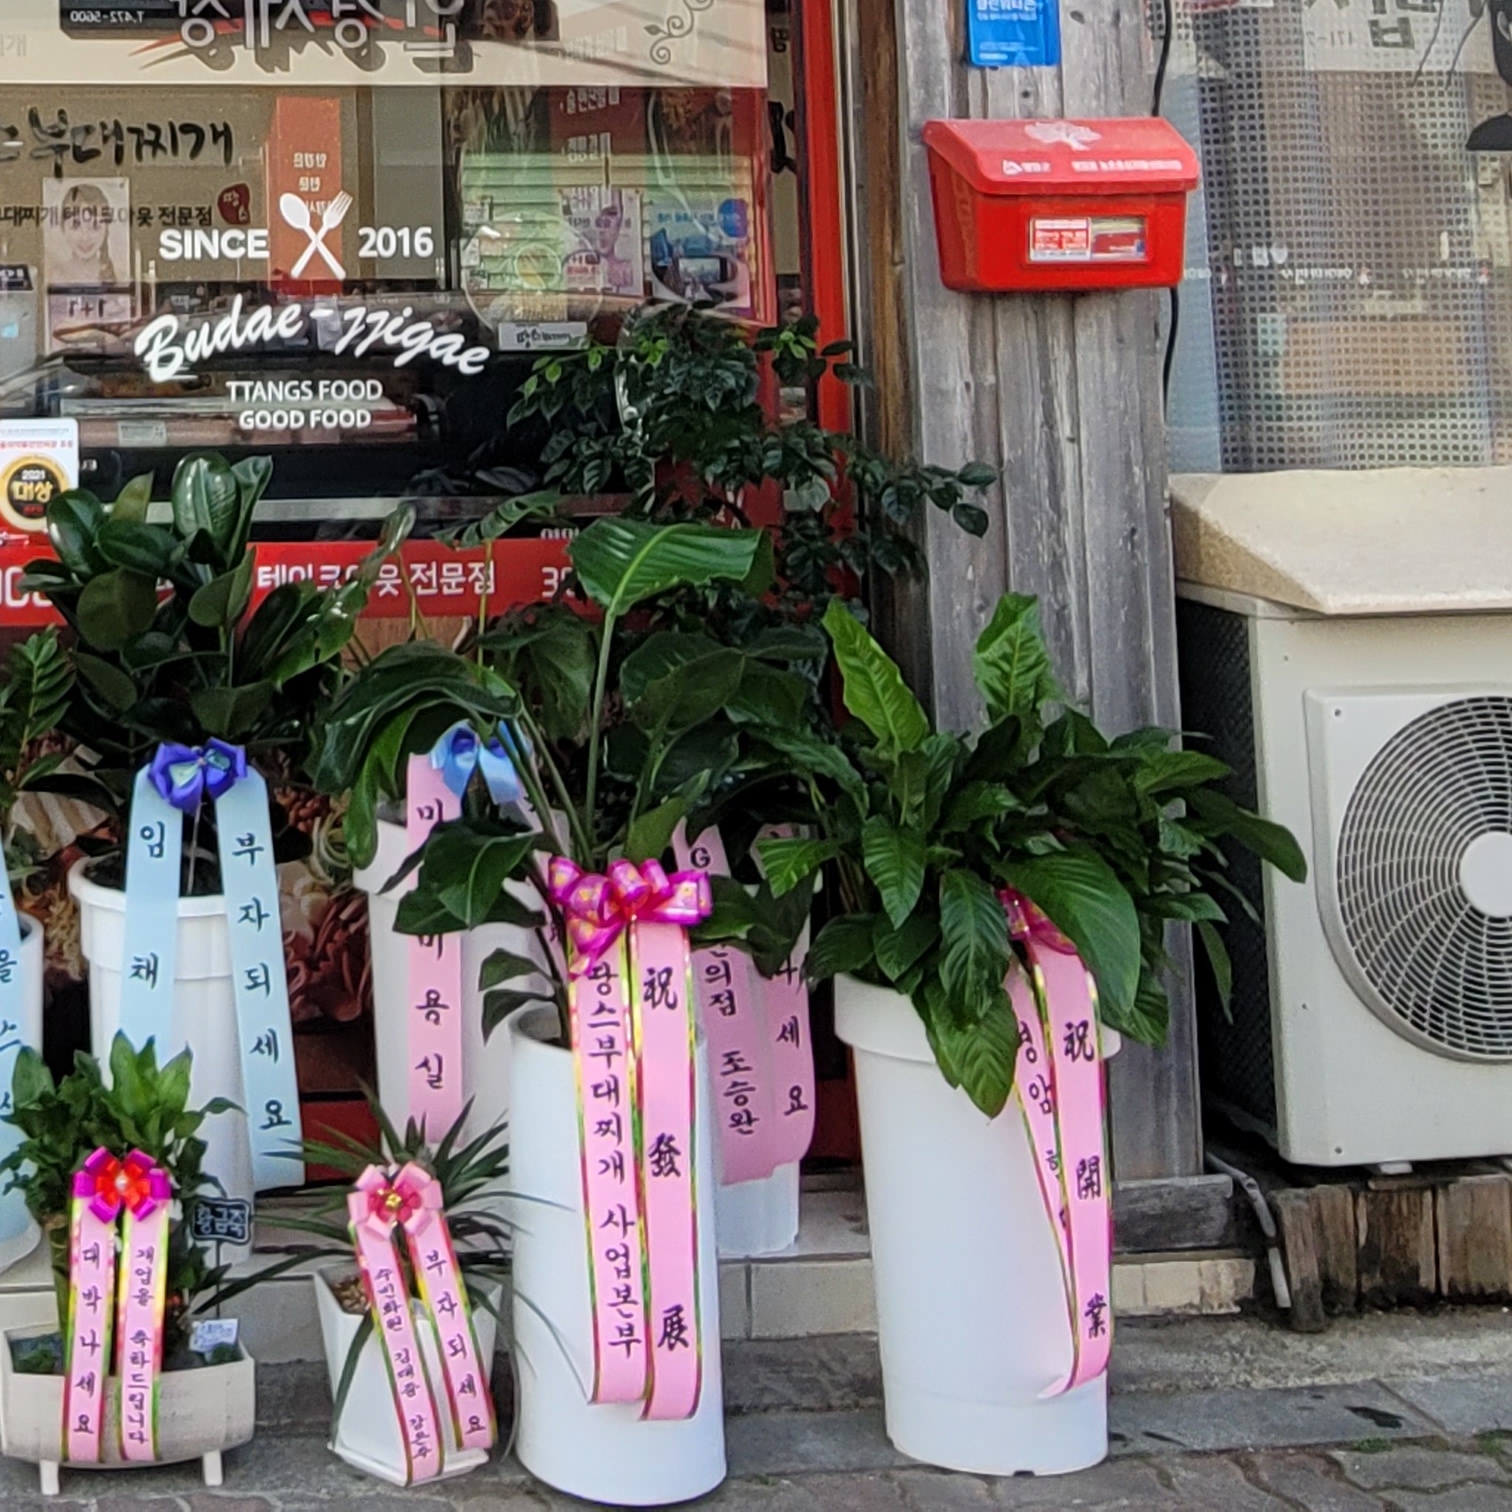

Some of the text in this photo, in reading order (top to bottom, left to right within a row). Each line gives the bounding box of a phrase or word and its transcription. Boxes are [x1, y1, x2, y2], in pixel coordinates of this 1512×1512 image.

[157, 204, 213, 228] 전문점
[158, 226, 435, 261] SINCE 2016
[225, 379, 384, 403] TTANGS FOOD
[238, 409, 372, 431] GOOD FOOD
[10, 480, 54, 503] 대상
[409, 559, 497, 597] 전문점
[231, 831, 292, 1132] 부자되세요
[599, 1204, 643, 1360] 사업본부
[73, 1240, 104, 1436] 대박나세요
[424, 1248, 488, 1436] 부자되세요
